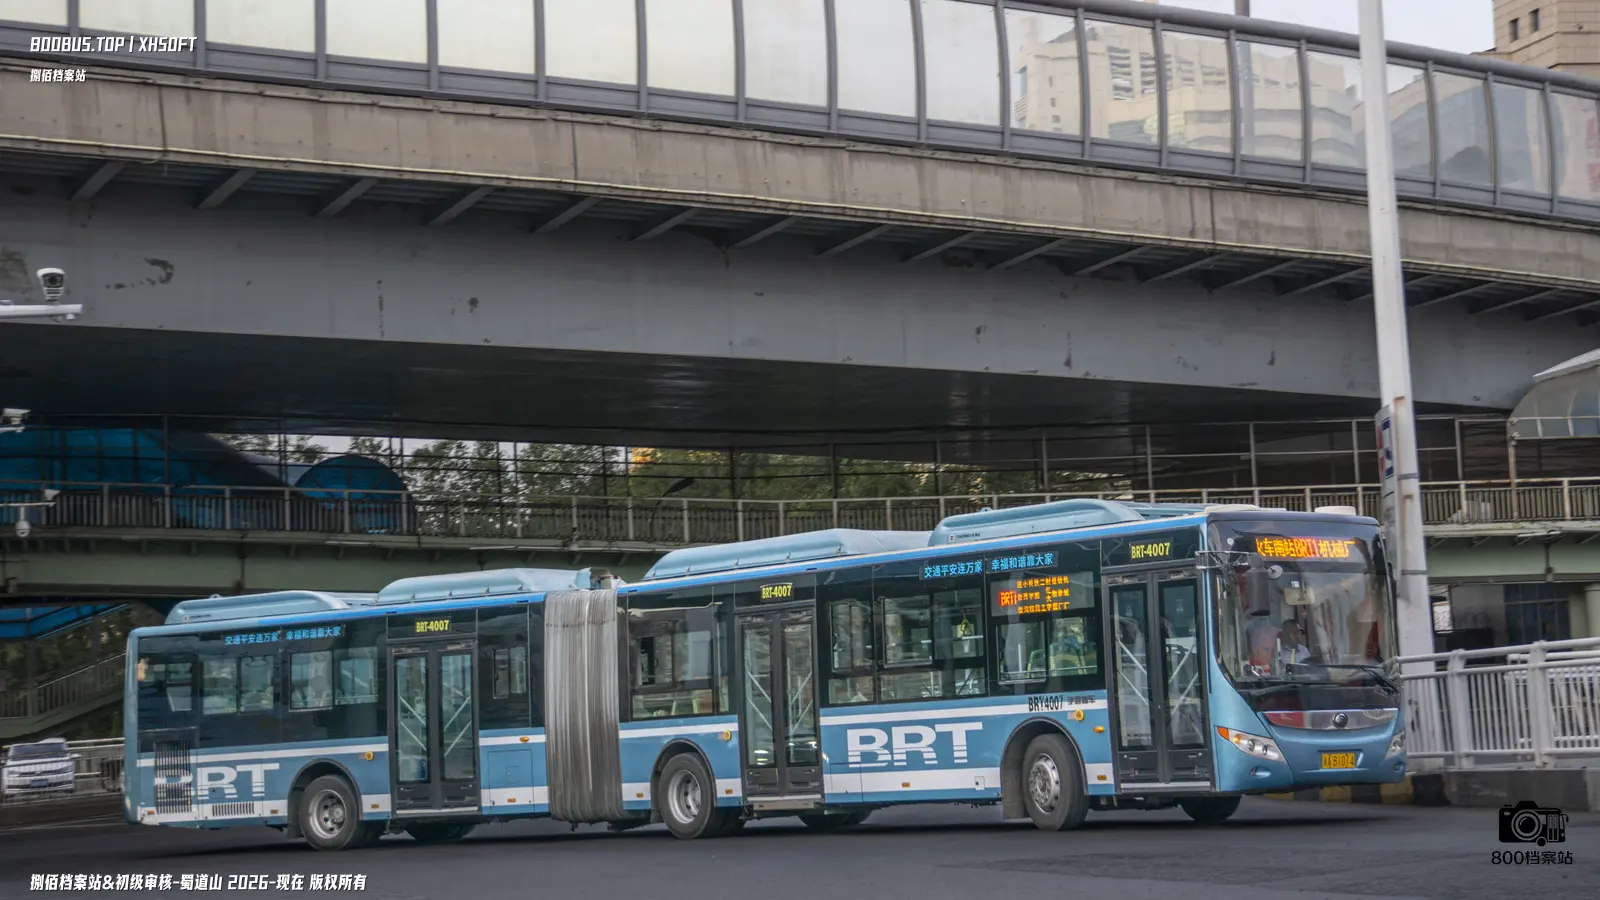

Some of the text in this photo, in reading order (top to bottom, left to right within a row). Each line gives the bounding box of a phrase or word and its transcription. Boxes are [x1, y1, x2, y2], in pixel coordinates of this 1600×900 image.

[1131, 542, 1171, 559] BRT-4007
[924, 552, 1054, 578] 交通平安连万家 幸福和谐靠大家
[761, 585, 792, 599] BRT-4007
[415, 619, 450, 633] BRT-4007
[847, 721, 984, 768] BRT
[154, 763, 279, 801] BRT
